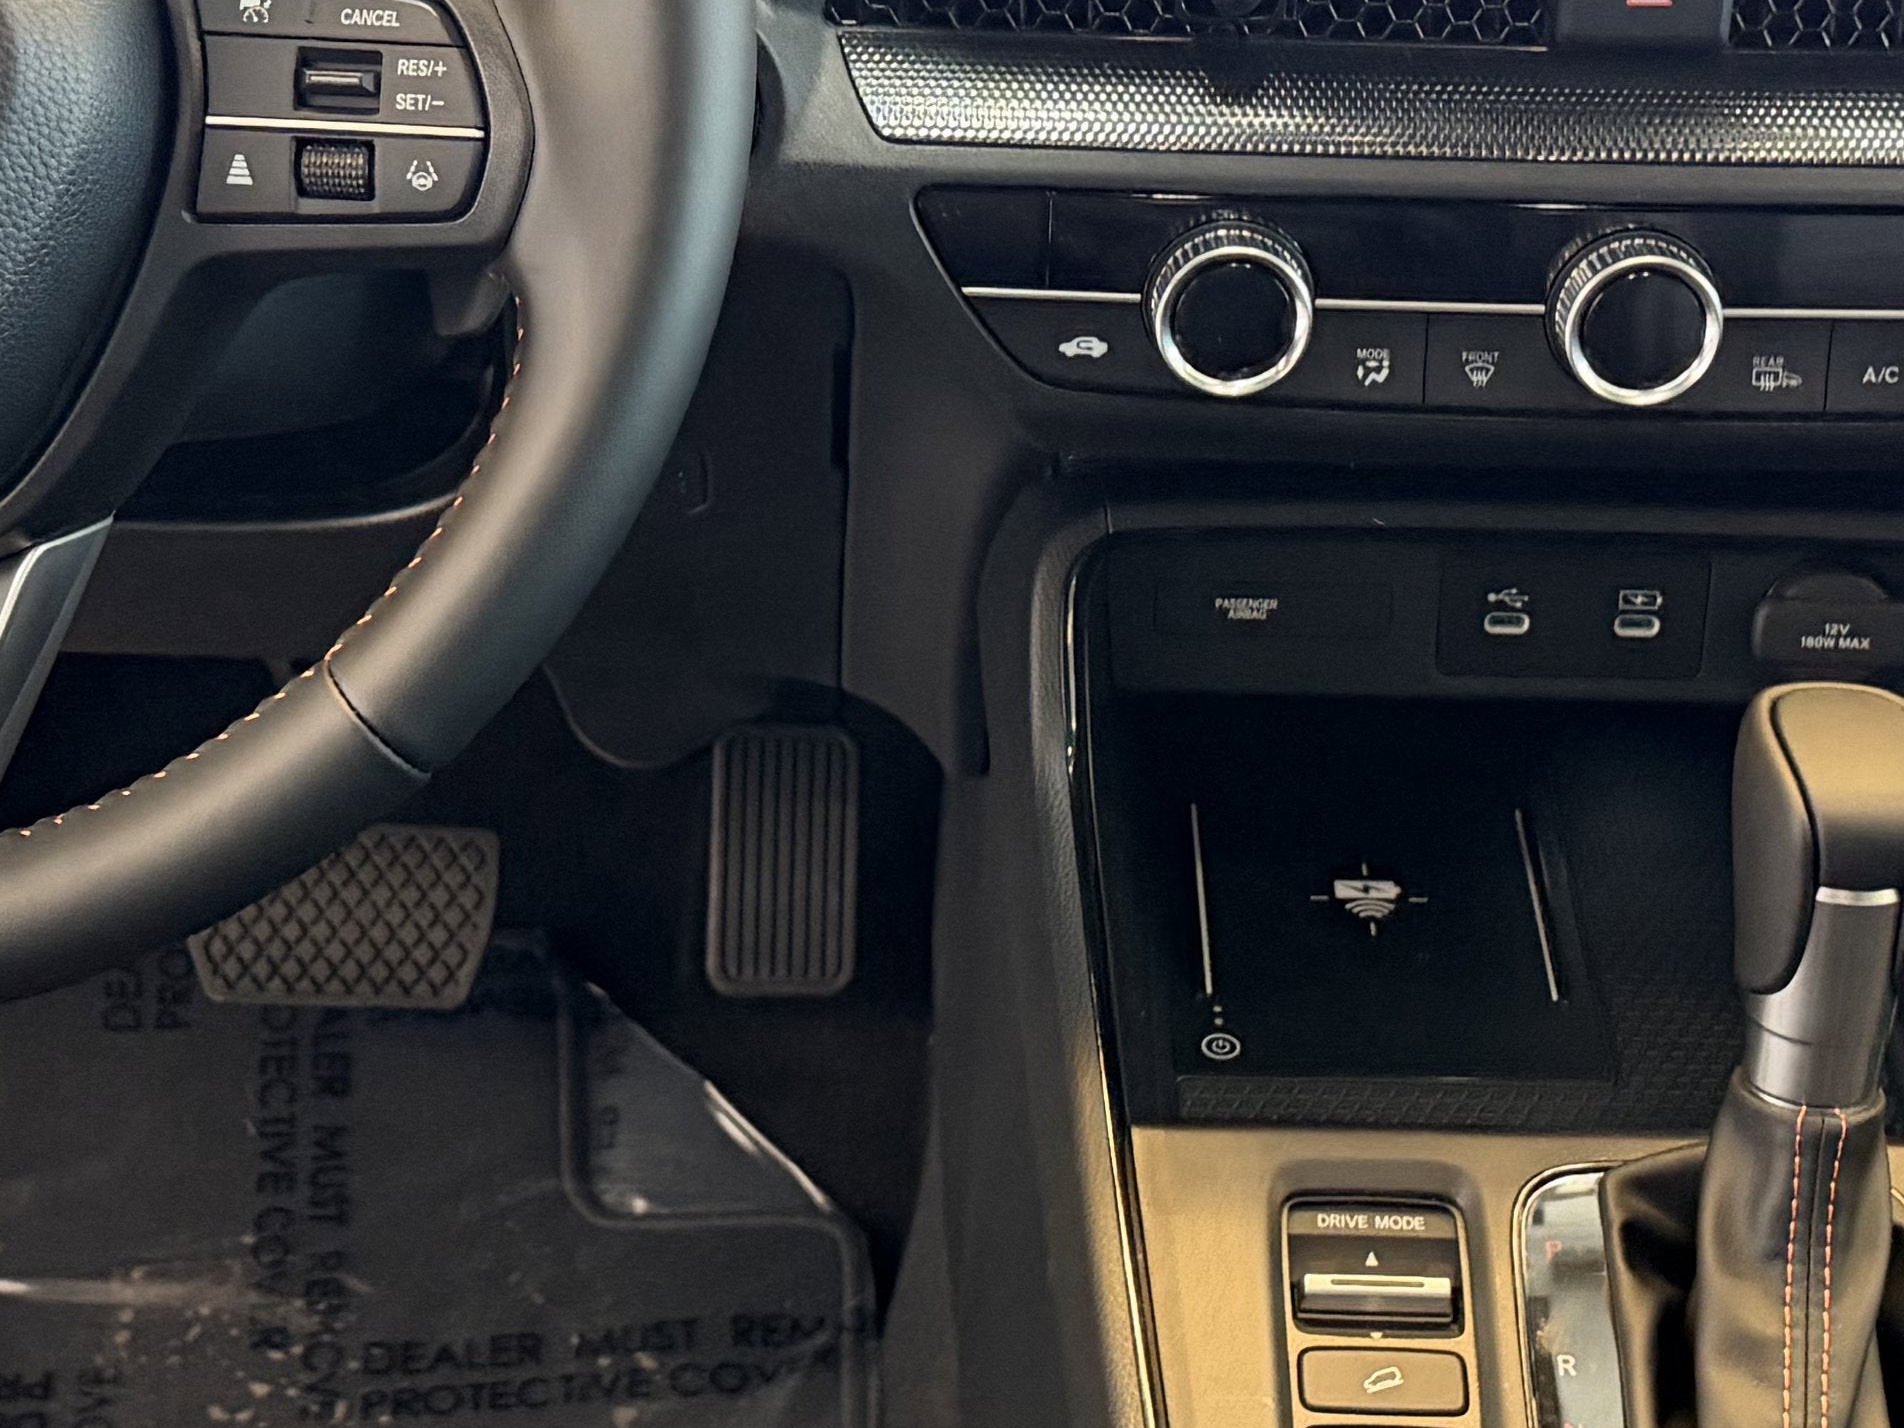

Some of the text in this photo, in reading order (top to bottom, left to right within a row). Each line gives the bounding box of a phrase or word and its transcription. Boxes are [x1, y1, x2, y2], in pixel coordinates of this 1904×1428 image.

[340, 8, 401, 28] CANCEL
[397, 58, 448, 78] RES/+
[1356, 348, 1390, 359] MODE
[1461, 351, 1499, 363] FRONT
[1752, 356, 1785, 367] REAR
[1862, 365, 1900, 384] A/C
[1824, 622, 1851, 635] 12V
[1838, 636, 1871, 649] MAX
[1316, 1212, 1426, 1231] DRIVE MODE
[1545, 1240, 1563, 1259] P
[362, 1325, 543, 1374] DEALER
[575, 1316, 699, 1360] MUST
[1557, 1354, 1577, 1376] R
[360, 1368, 652, 1420] PROTECTIVE
